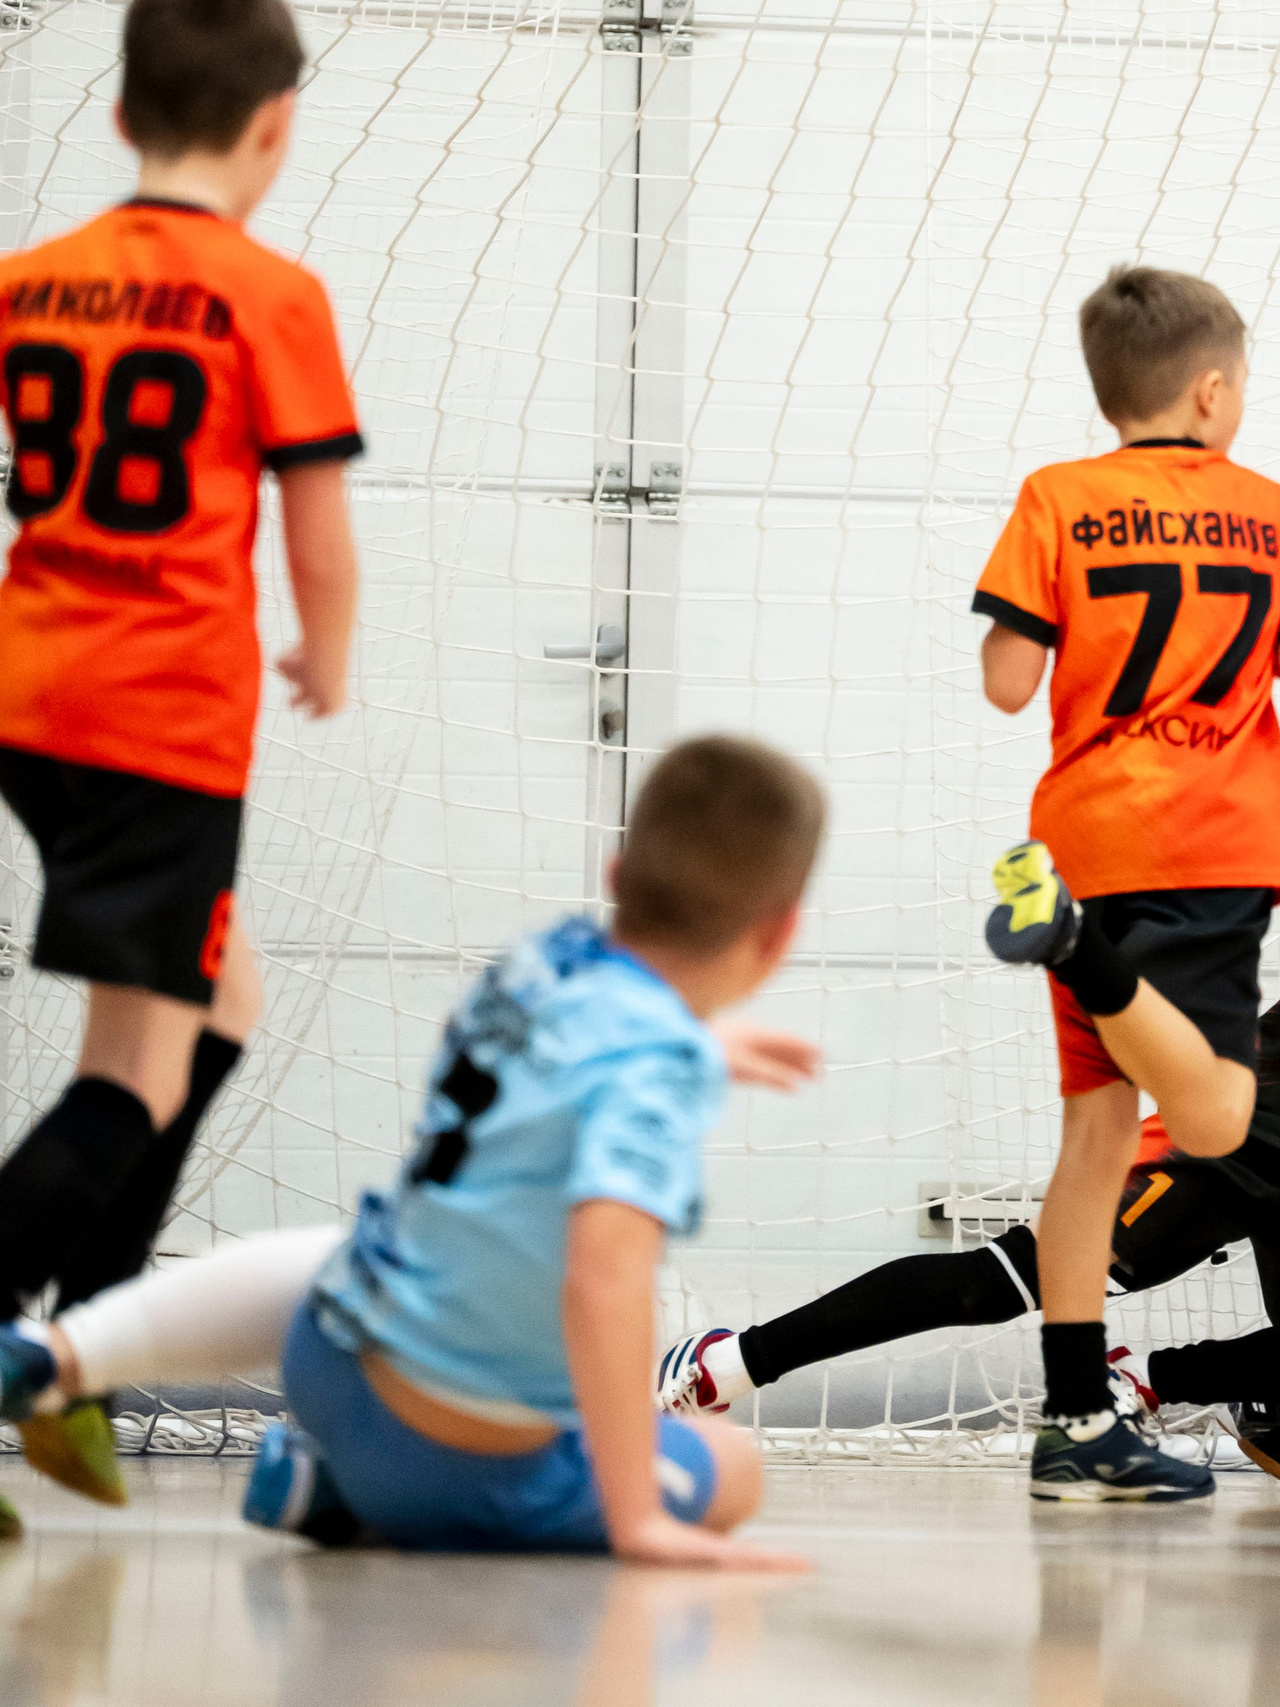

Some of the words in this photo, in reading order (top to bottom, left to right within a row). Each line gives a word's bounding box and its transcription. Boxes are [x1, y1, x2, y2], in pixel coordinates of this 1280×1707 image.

[6, 343, 207, 533] 88
[1086, 563, 1273, 718] 77
[1120, 1171, 1174, 1228] 1
